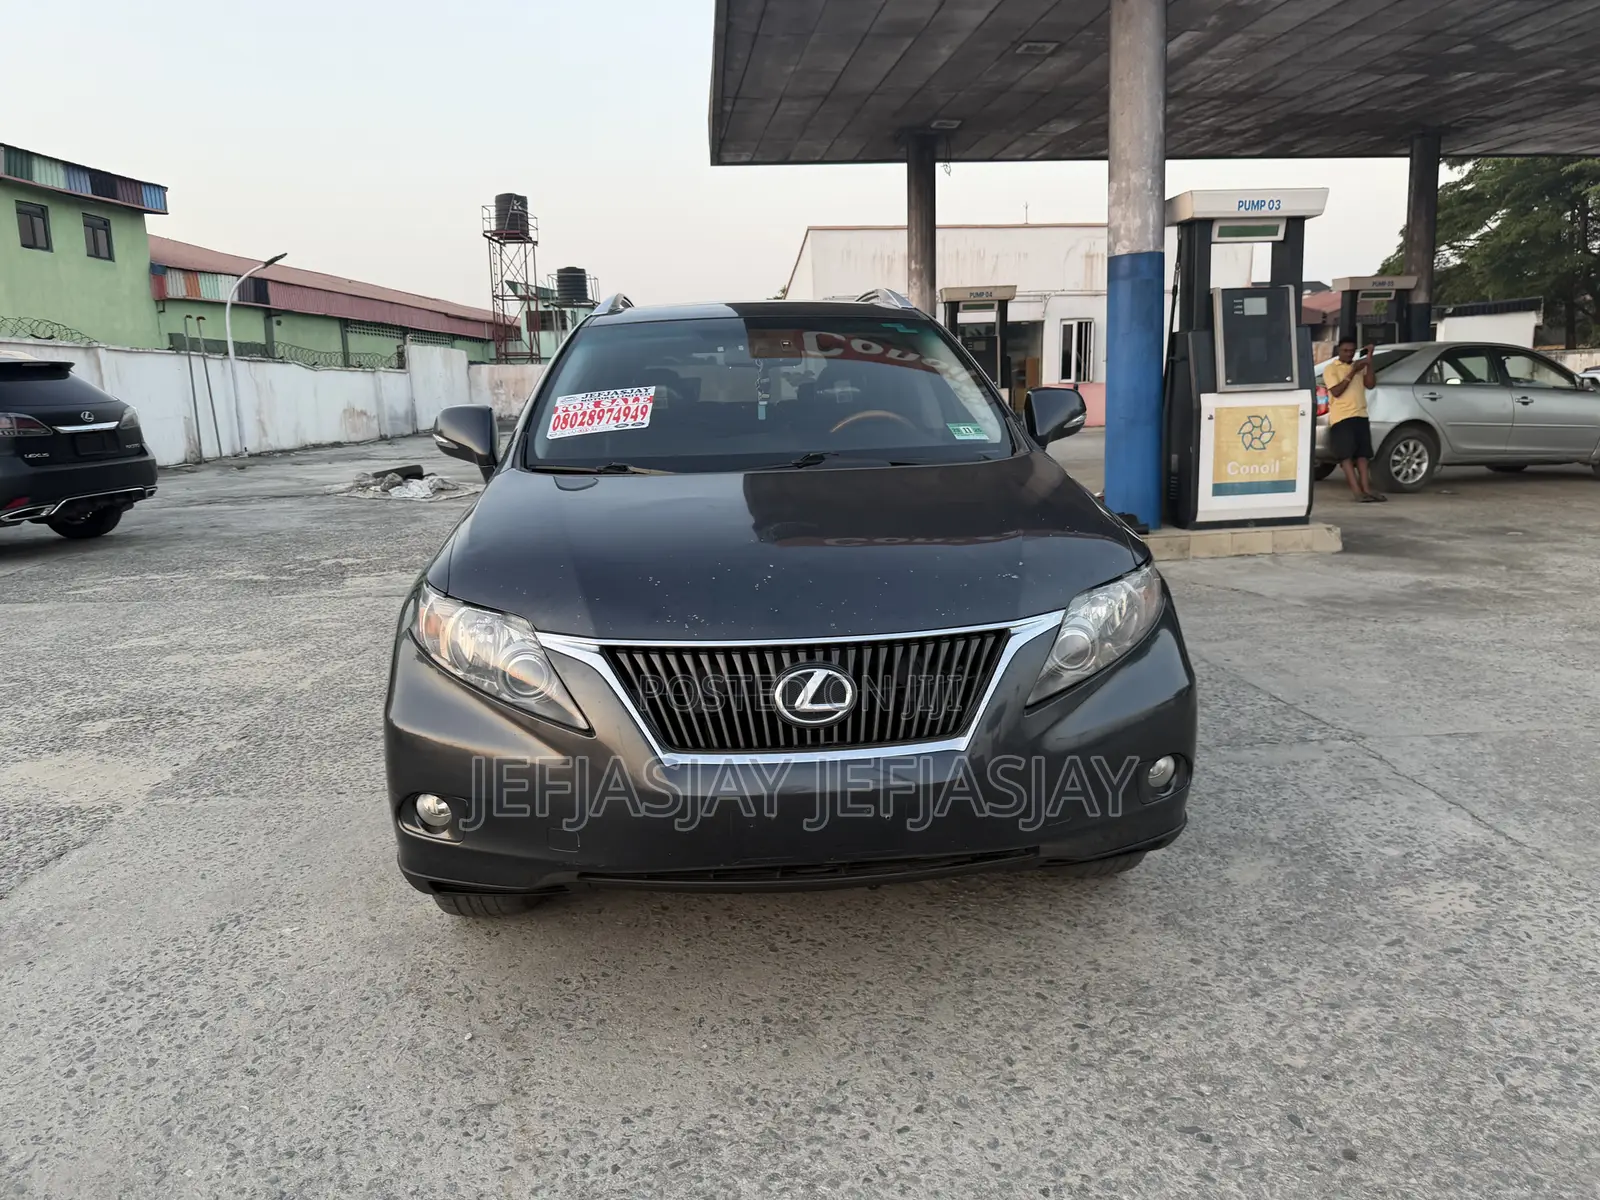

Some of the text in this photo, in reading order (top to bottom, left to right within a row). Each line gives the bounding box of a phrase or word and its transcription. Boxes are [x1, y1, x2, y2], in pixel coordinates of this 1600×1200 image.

[1237, 199, 1281, 211] PUMP 03
[969, 291, 985, 299] PUMP
[581, 387, 652, 399] JEFJASJAY
[556, 396, 651, 414] FOR SALE
[552, 404, 649, 431] 08028974949
[1227, 459, 1280, 475] Conoil
